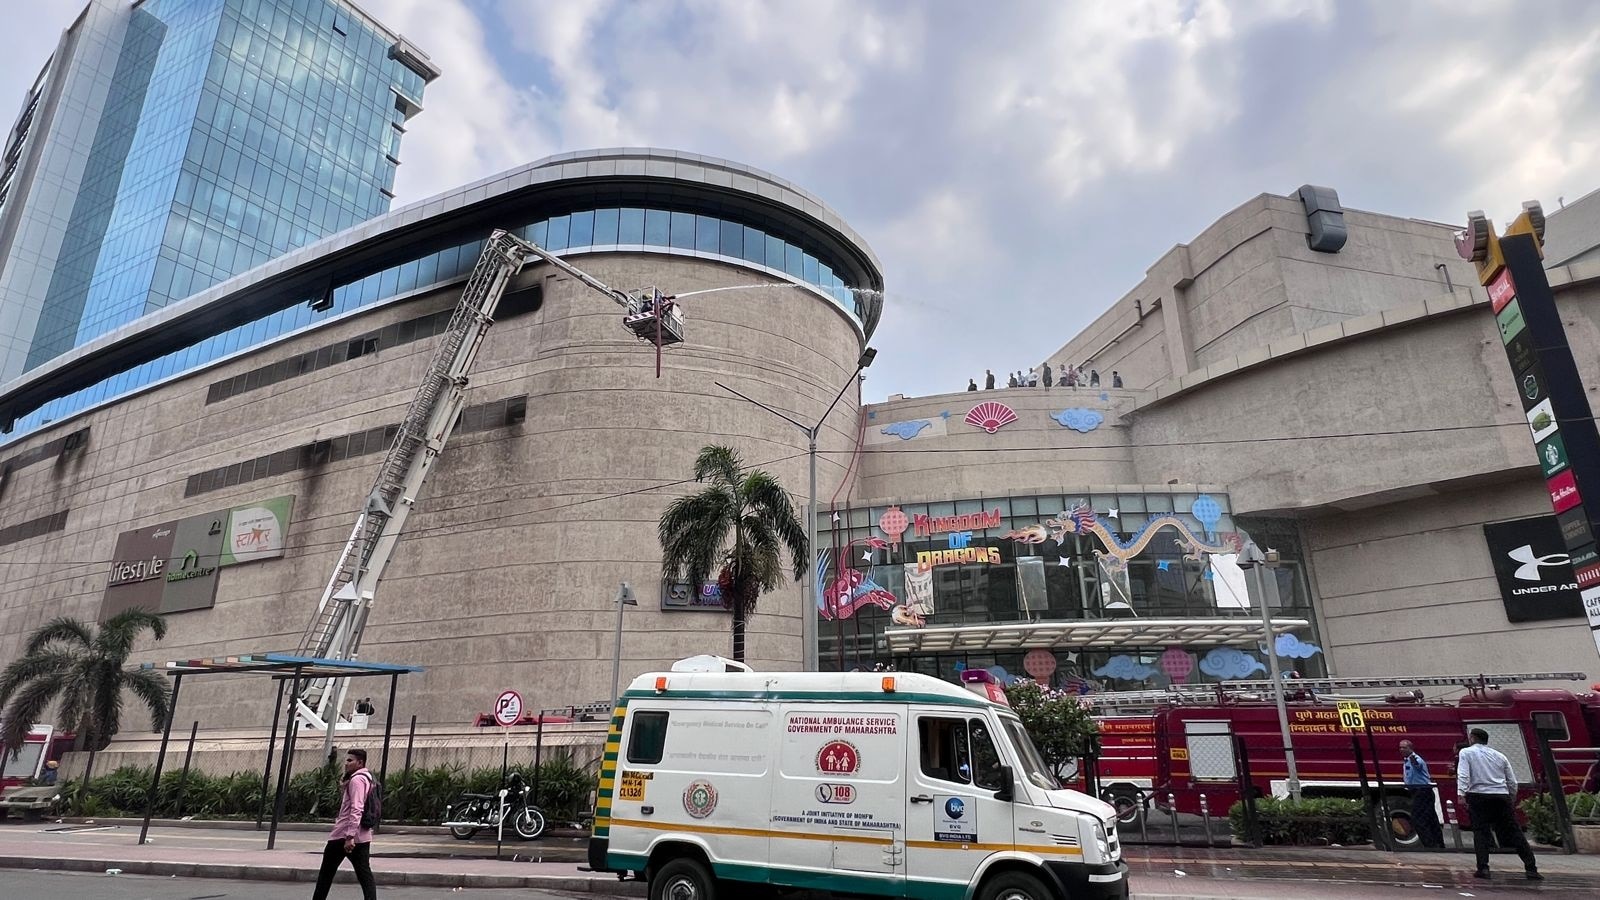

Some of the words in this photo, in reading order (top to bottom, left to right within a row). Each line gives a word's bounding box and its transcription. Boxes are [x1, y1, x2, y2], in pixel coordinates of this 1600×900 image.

[914, 507, 1001, 537] KINGDOM
[948, 531, 973, 549] OF
[917, 547, 1001, 574] DRAGONS
[1512, 585, 1557, 595] UNDER
[1559, 583, 1579, 591] AR
[1338, 702, 1350, 710] GATE
[790, 716, 820, 725] NATIONAL
[823, 717, 864, 726] AMBULANCE
[866, 718, 895, 727] SERVICE
[1342, 712, 1362, 727] 06
[788, 725, 832, 733] GOVERNMENT
[834, 726, 843, 734] OF
[845, 727, 897, 735] MAHARASHTRA
[834, 786, 850, 798] 108
